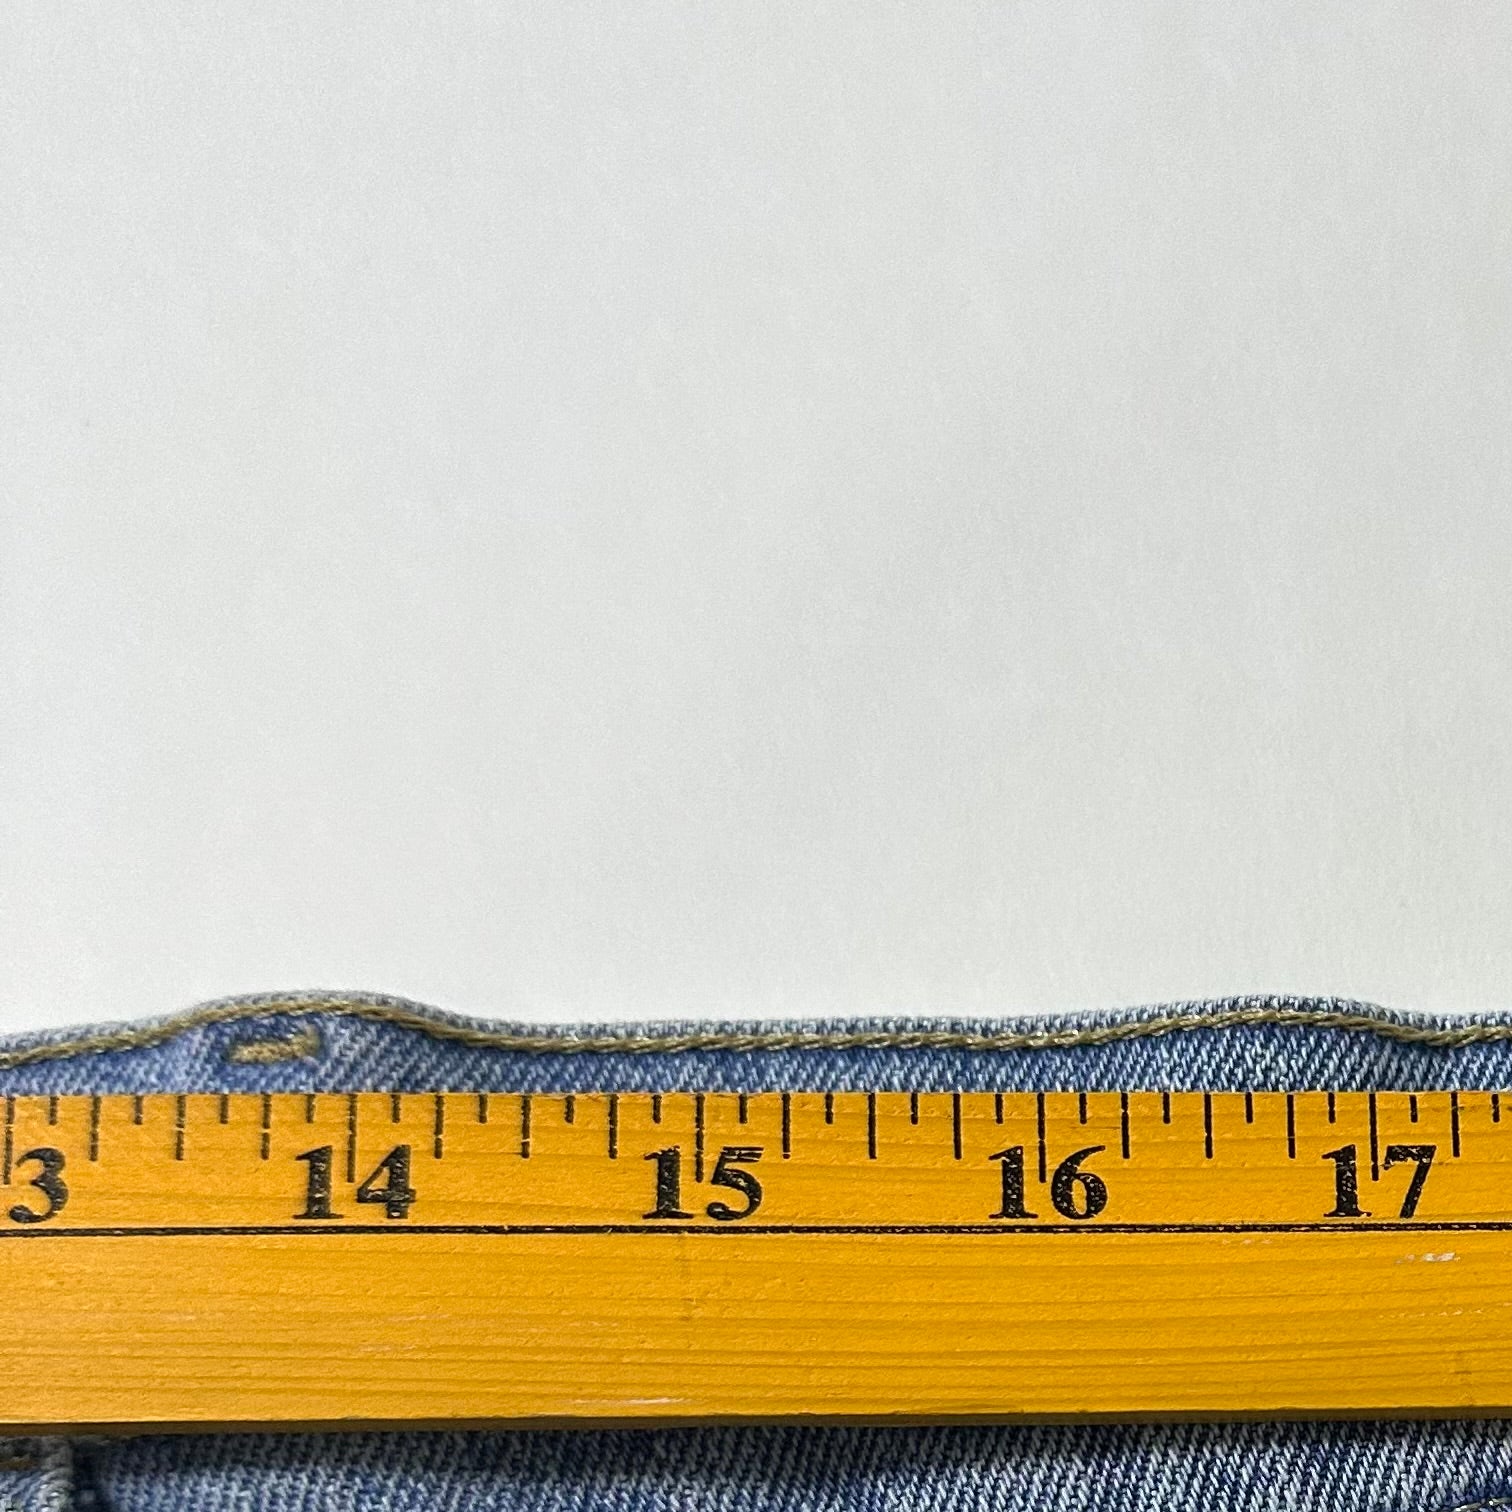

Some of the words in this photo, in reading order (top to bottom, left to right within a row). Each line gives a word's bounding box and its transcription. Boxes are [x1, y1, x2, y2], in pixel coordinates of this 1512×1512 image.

[292, 1144, 418, 1221] 14
[640, 1144, 765, 1221] 15
[987, 1144, 1109, 1221] 16
[1320, 1143, 1438, 1220] 17
